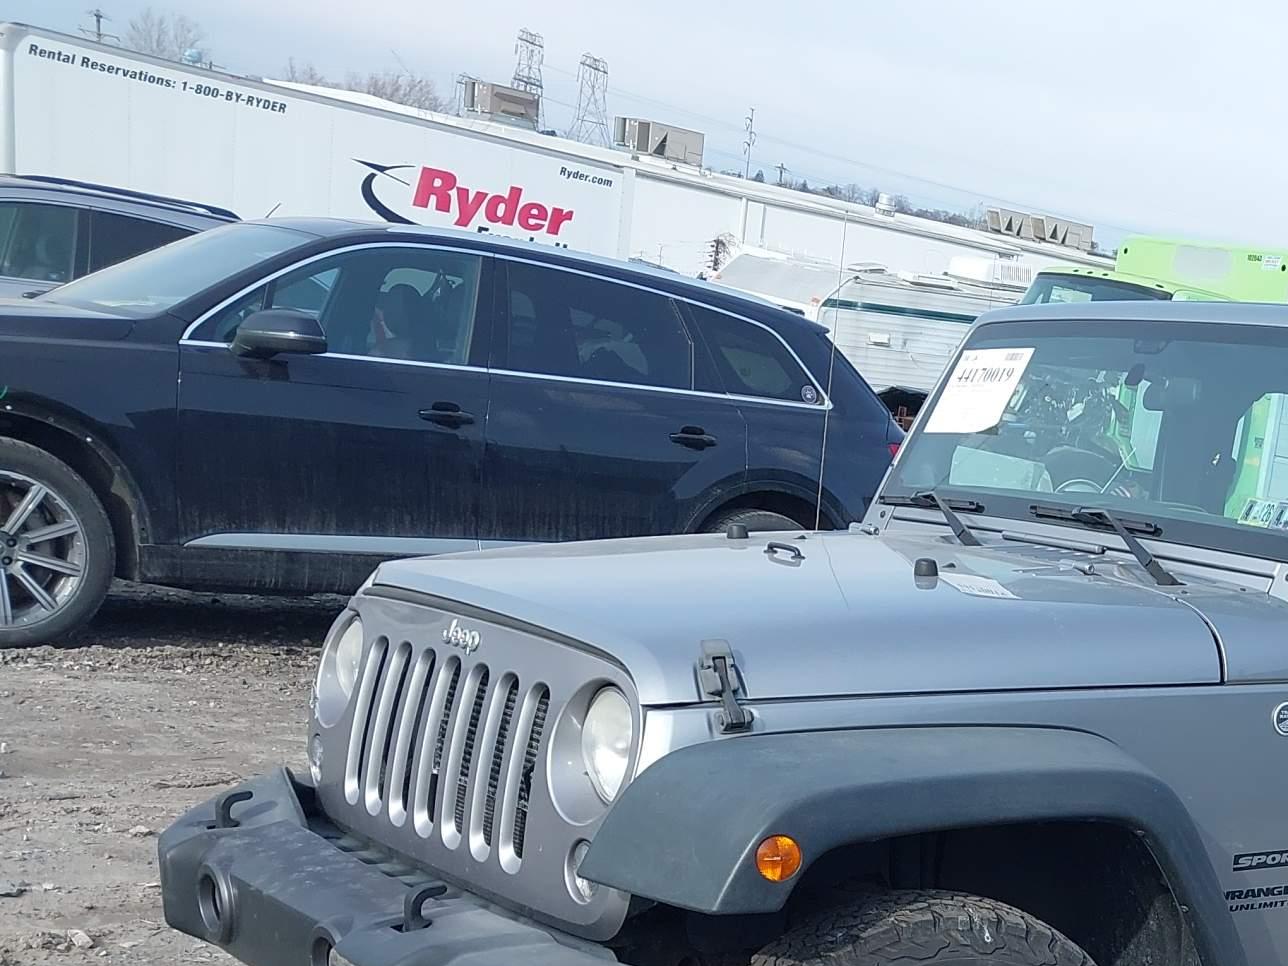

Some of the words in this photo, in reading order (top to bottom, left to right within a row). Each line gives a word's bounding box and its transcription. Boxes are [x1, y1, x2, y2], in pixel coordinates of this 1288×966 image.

[28, 43, 76, 65] Rental
[80, 56, 177, 88] Reservations:
[180, 80, 288, 114] 1-800-BY-RYDER
[559, 166, 613, 188] Ryder.com
[412, 166, 575, 236] Ryder
[957, 367, 1015, 383] 44170019
[442, 618, 480, 656] Jeep
